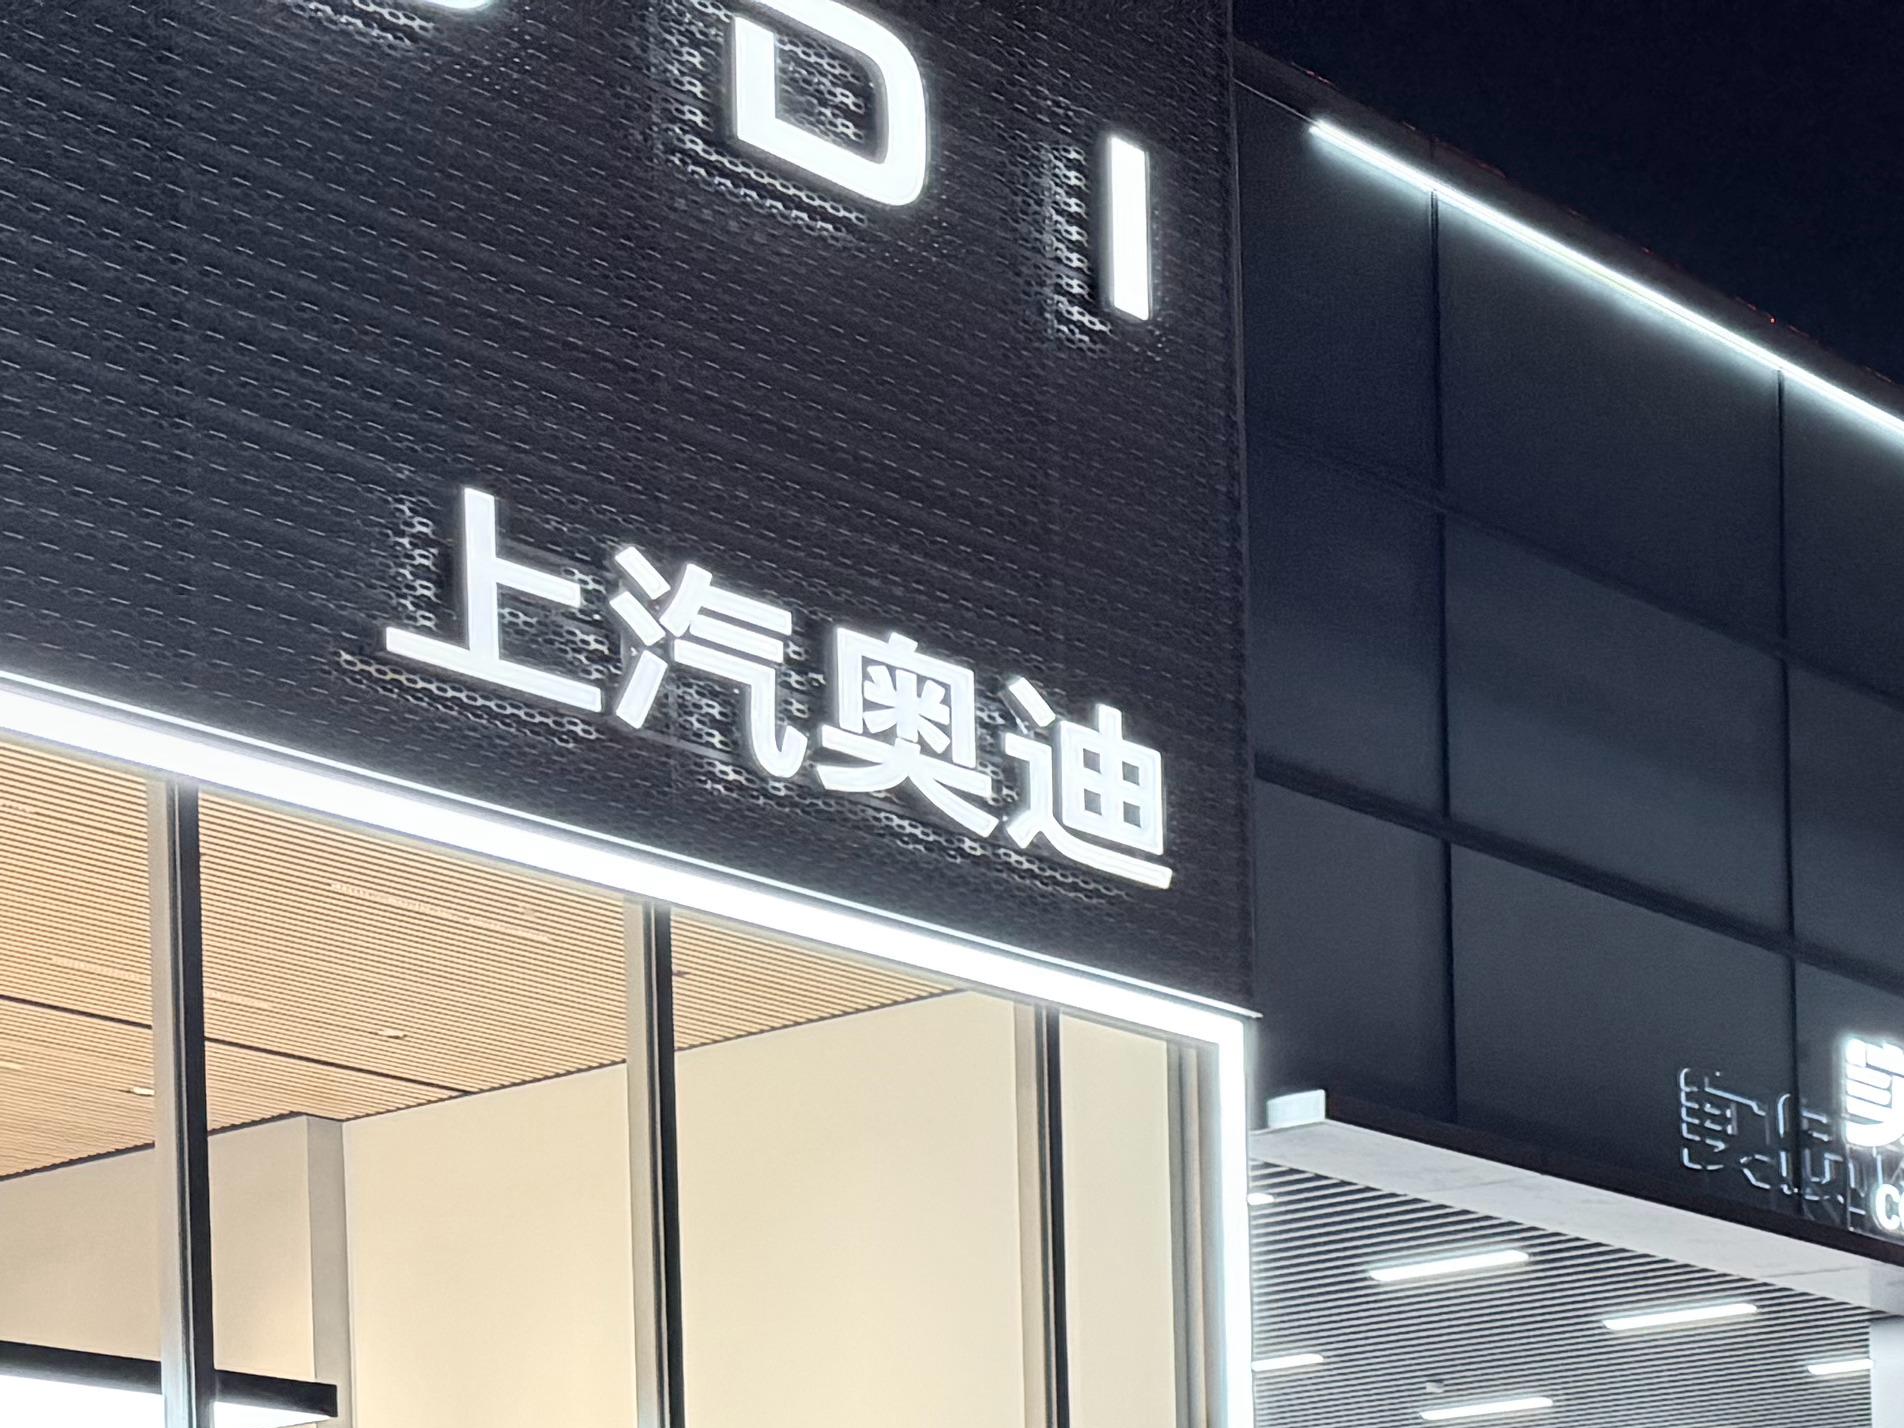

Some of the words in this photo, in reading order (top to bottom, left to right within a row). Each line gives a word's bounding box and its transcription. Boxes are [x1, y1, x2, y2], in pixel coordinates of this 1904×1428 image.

[425, 0, 1152, 322] DI
[384, 486, 1174, 891] 上汽奥迪
